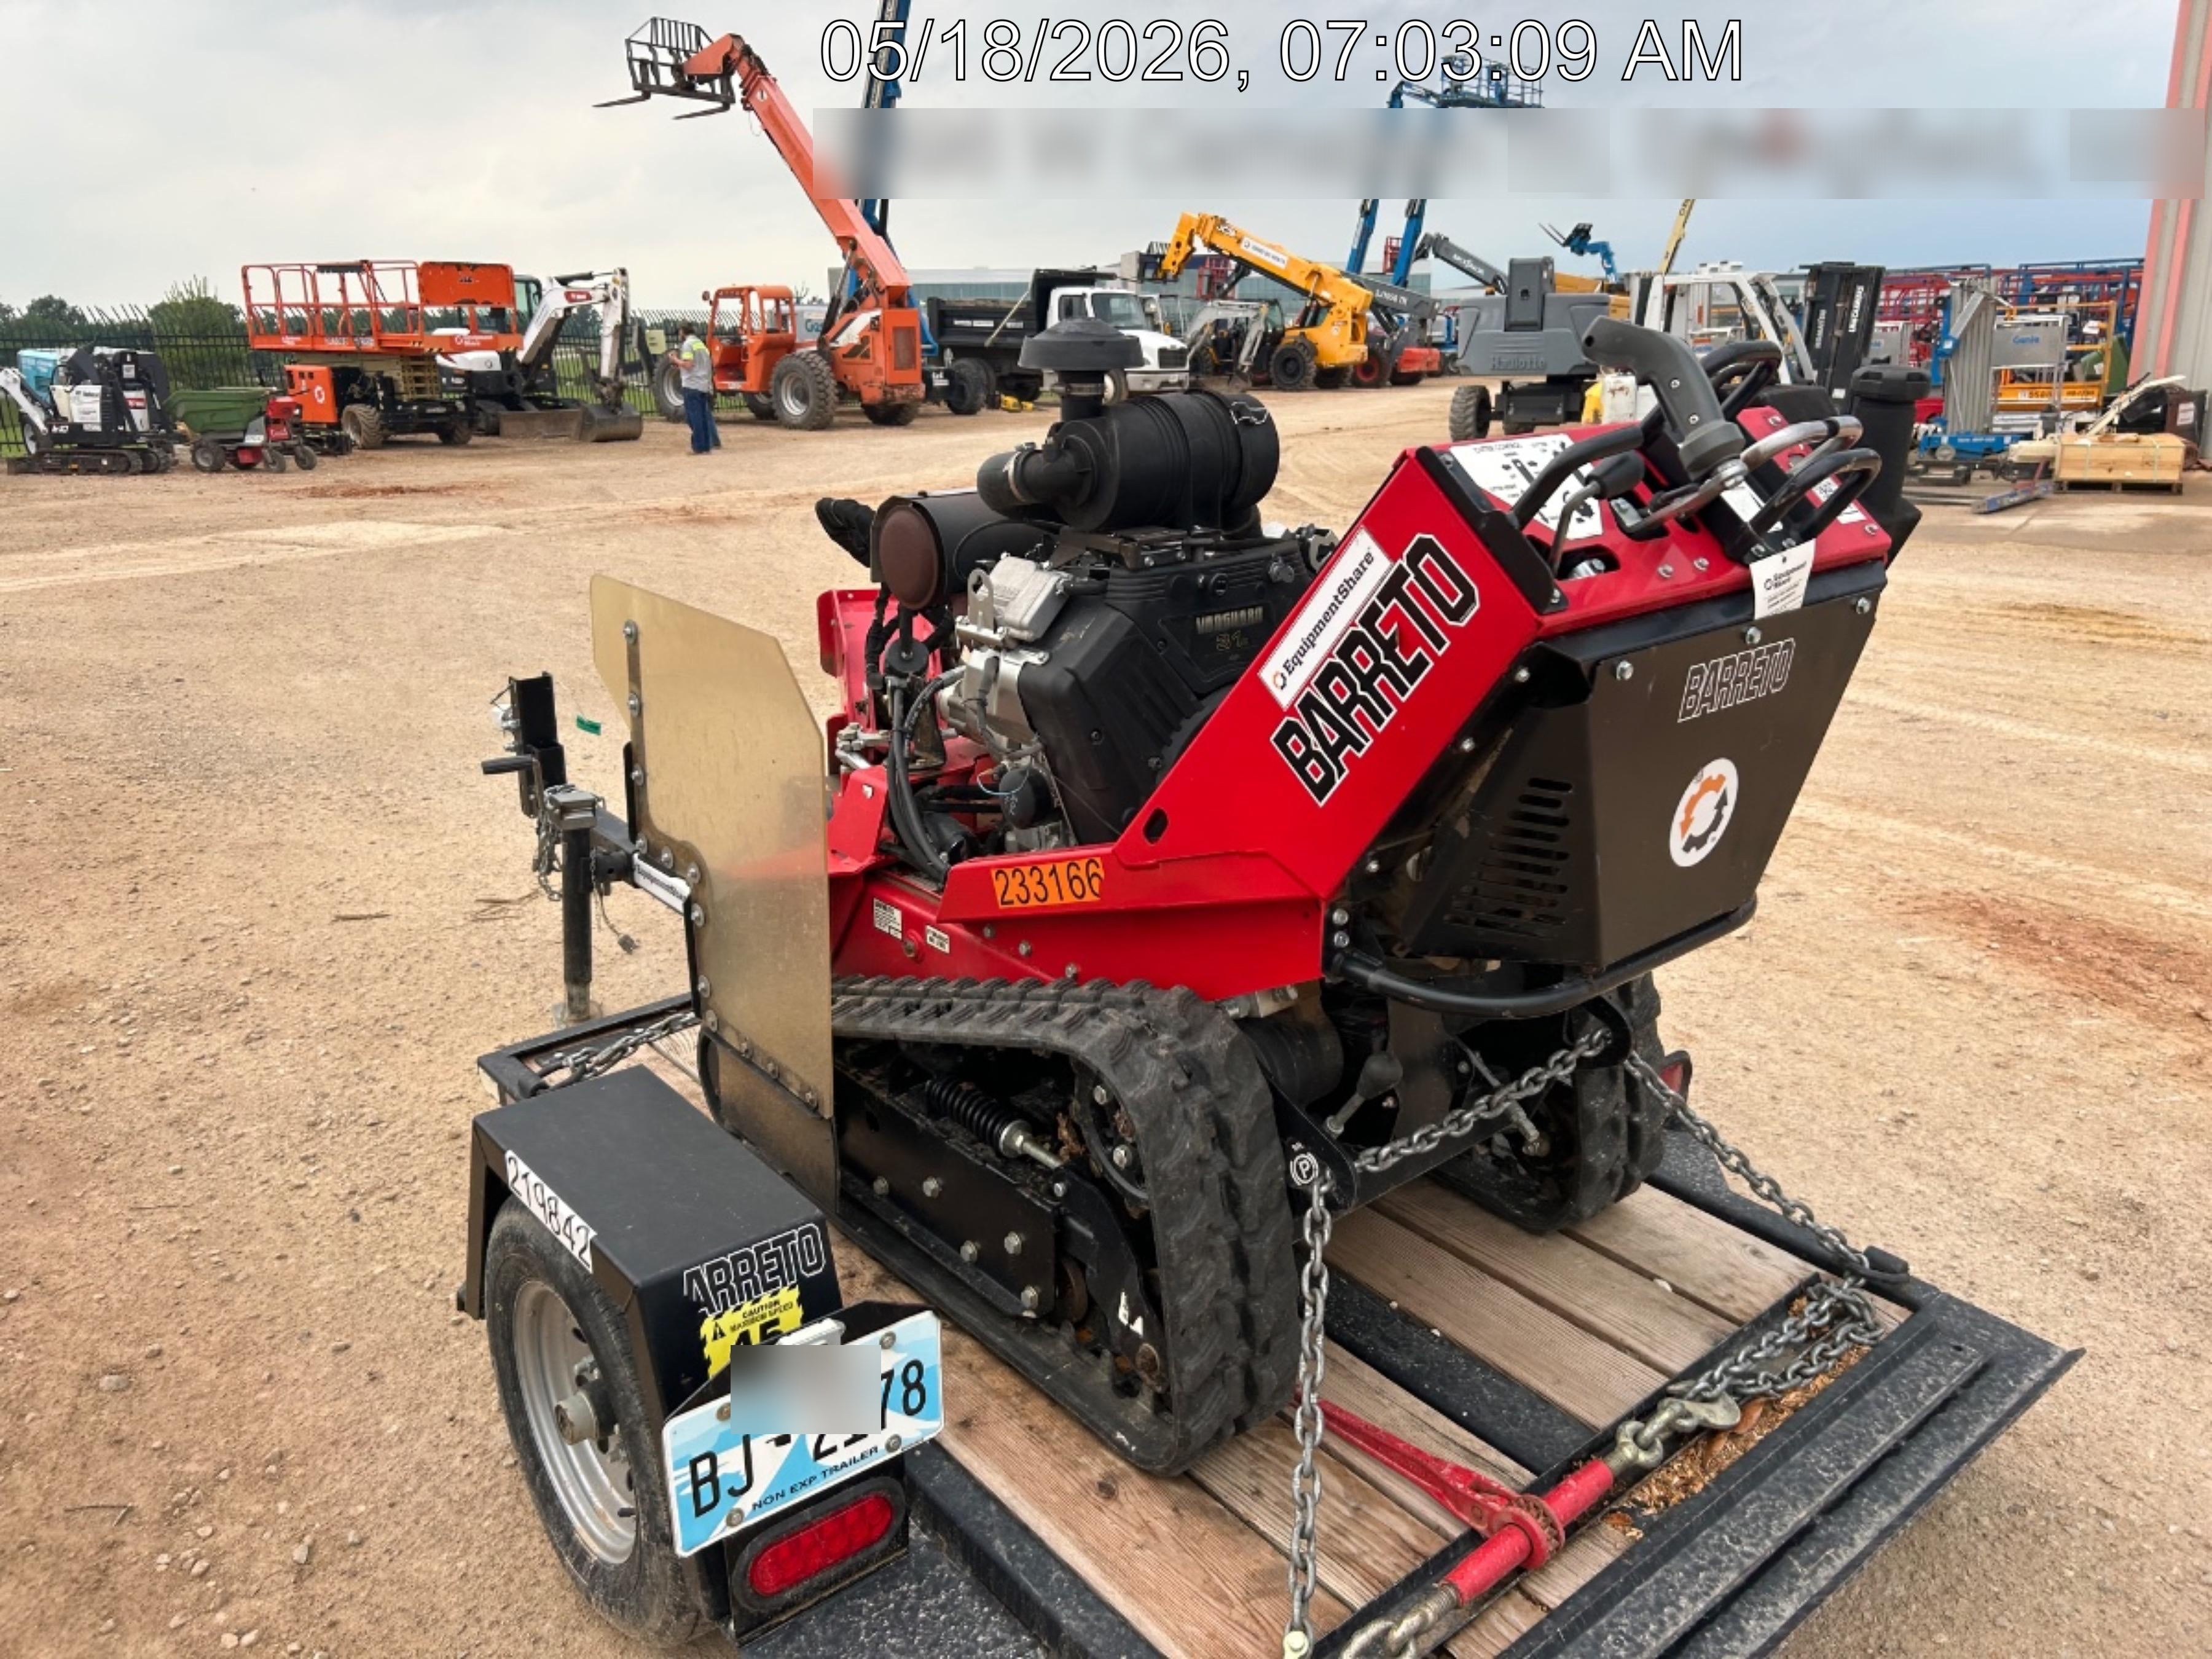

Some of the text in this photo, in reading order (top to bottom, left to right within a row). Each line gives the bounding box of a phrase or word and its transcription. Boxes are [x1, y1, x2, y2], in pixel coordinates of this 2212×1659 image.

[1282, 551, 1375, 677] EquipmentShare
[1270, 533, 1480, 807] BARRETO
[1677, 638, 1796, 723] BARRETO
[994, 858, 1104, 905] 233166
[508, 1156, 591, 1269] 219842
[751, 1445, 879, 1511] NON EXP TRAILER
